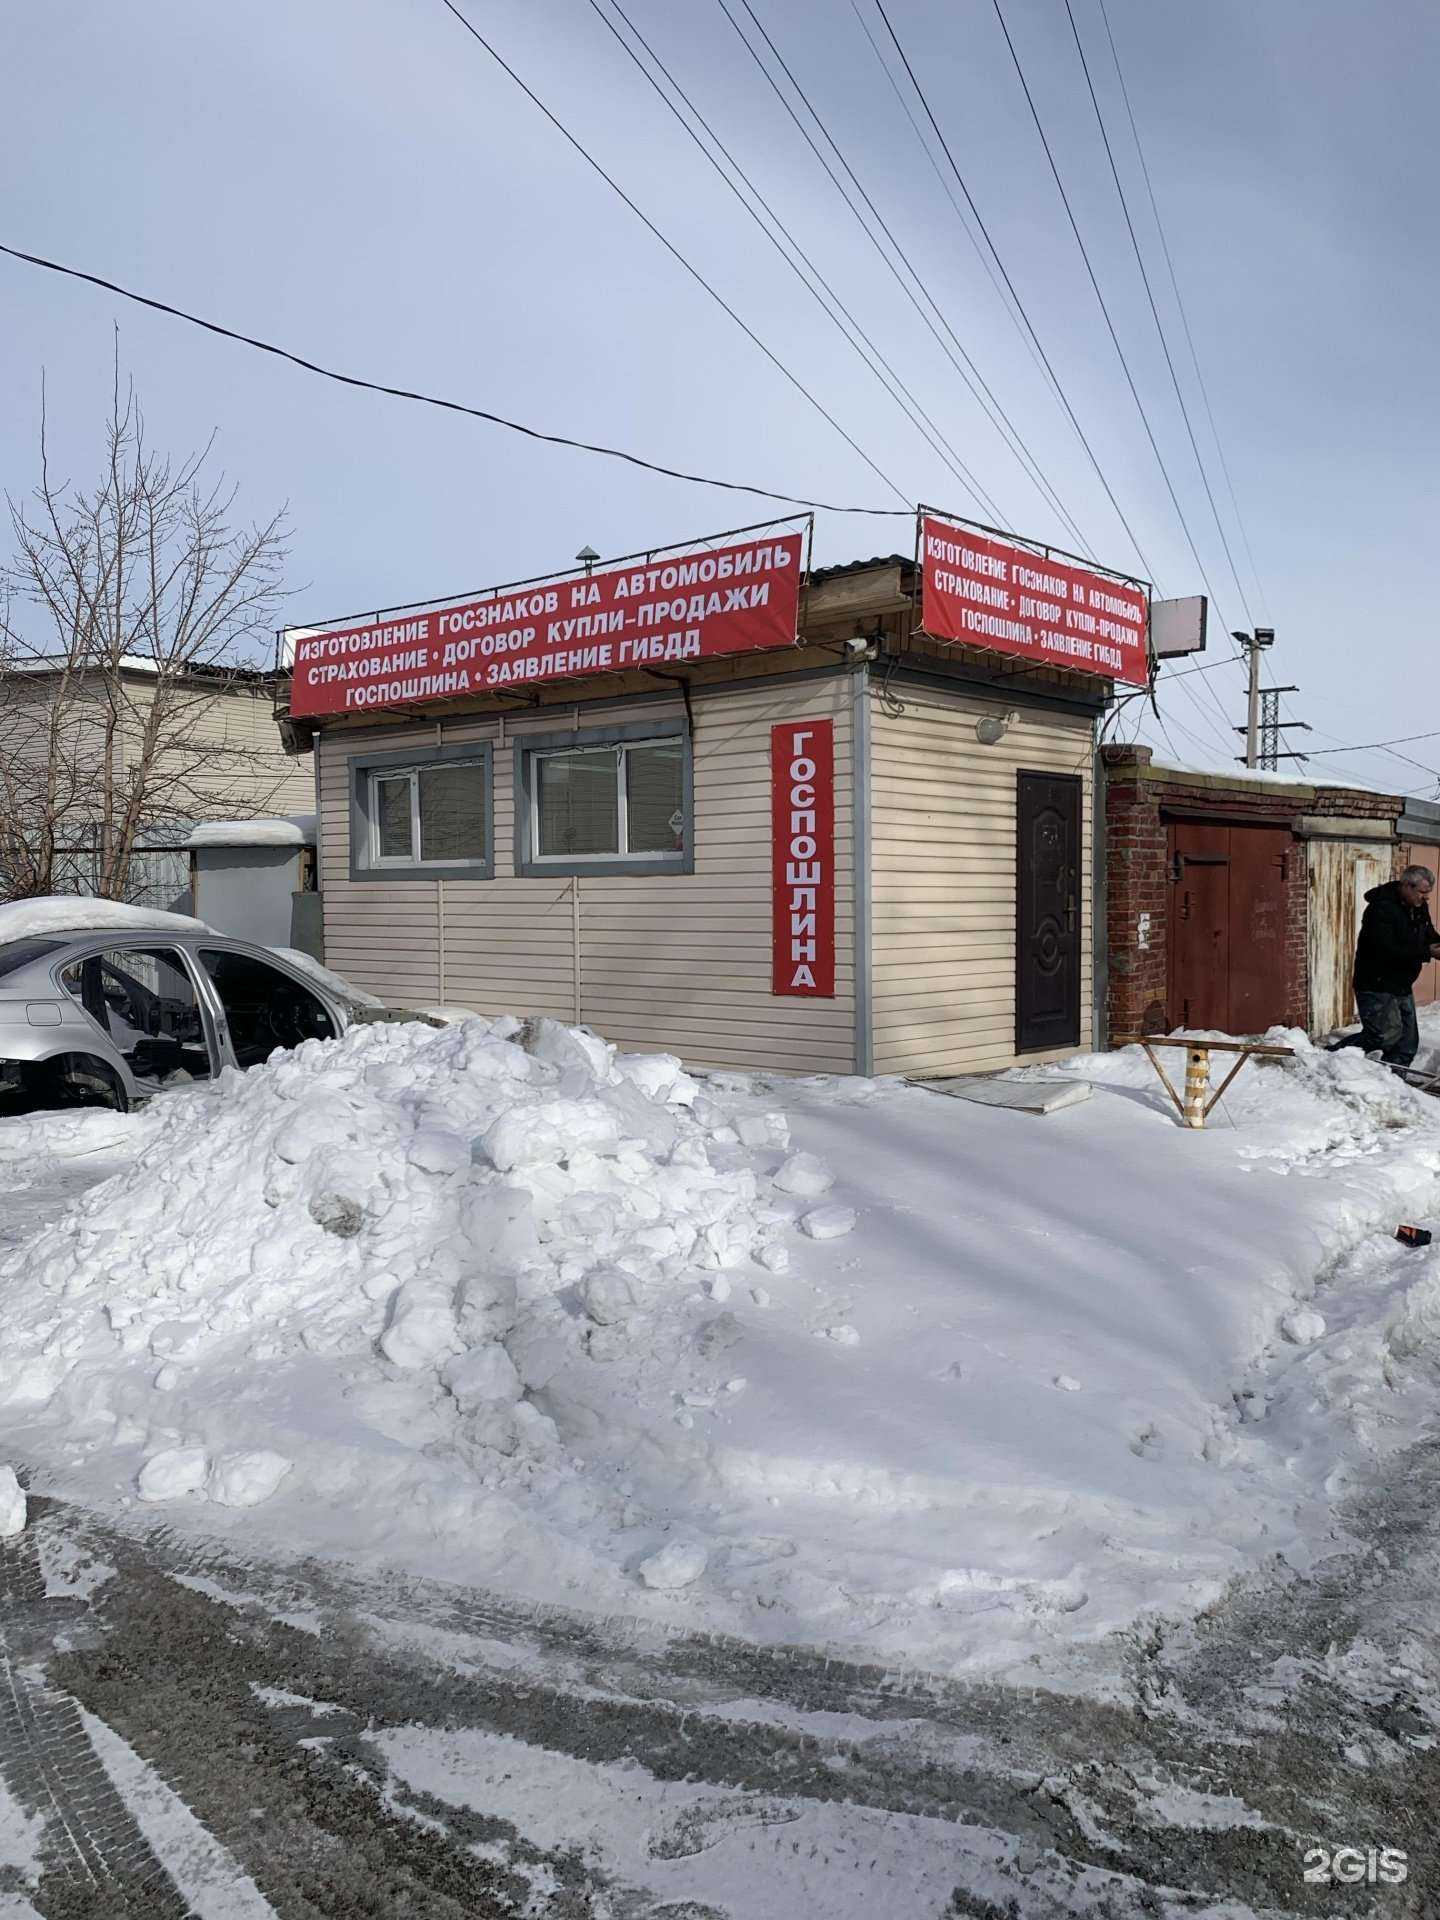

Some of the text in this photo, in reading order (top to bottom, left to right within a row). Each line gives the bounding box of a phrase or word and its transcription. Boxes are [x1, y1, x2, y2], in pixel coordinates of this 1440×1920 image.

[299, 545, 792, 661] ИЗГОТОВЛЕНИЕ ГОСЗНАКОВ НА АВТОМОБИЛЬ
[927, 534, 1142, 624] ИЗГОТОВЛЕНИЕ ГОСЗНАКОВ НА АВТОМОБИЛЬ
[934, 569, 1139, 648] СТРАХОВАНИЕ ДОГОВОР КУПЛИ-ПРОДАЖИ
[307, 582, 770, 685] СТРАХОВАНИЕ ДОГОВОР КУПЛИ-ПРОДАЖИ
[346, 629, 701, 707] ГОСПОШЛИНА ЗАЯВЛЕНИЕ ГИБДД
[961, 608, 1122, 671] ГОСПОШЛИНА ЗАЯВЛЕНИЕ ГИБДД
[786, 731, 821, 988] ГОСПОШЛИНА
